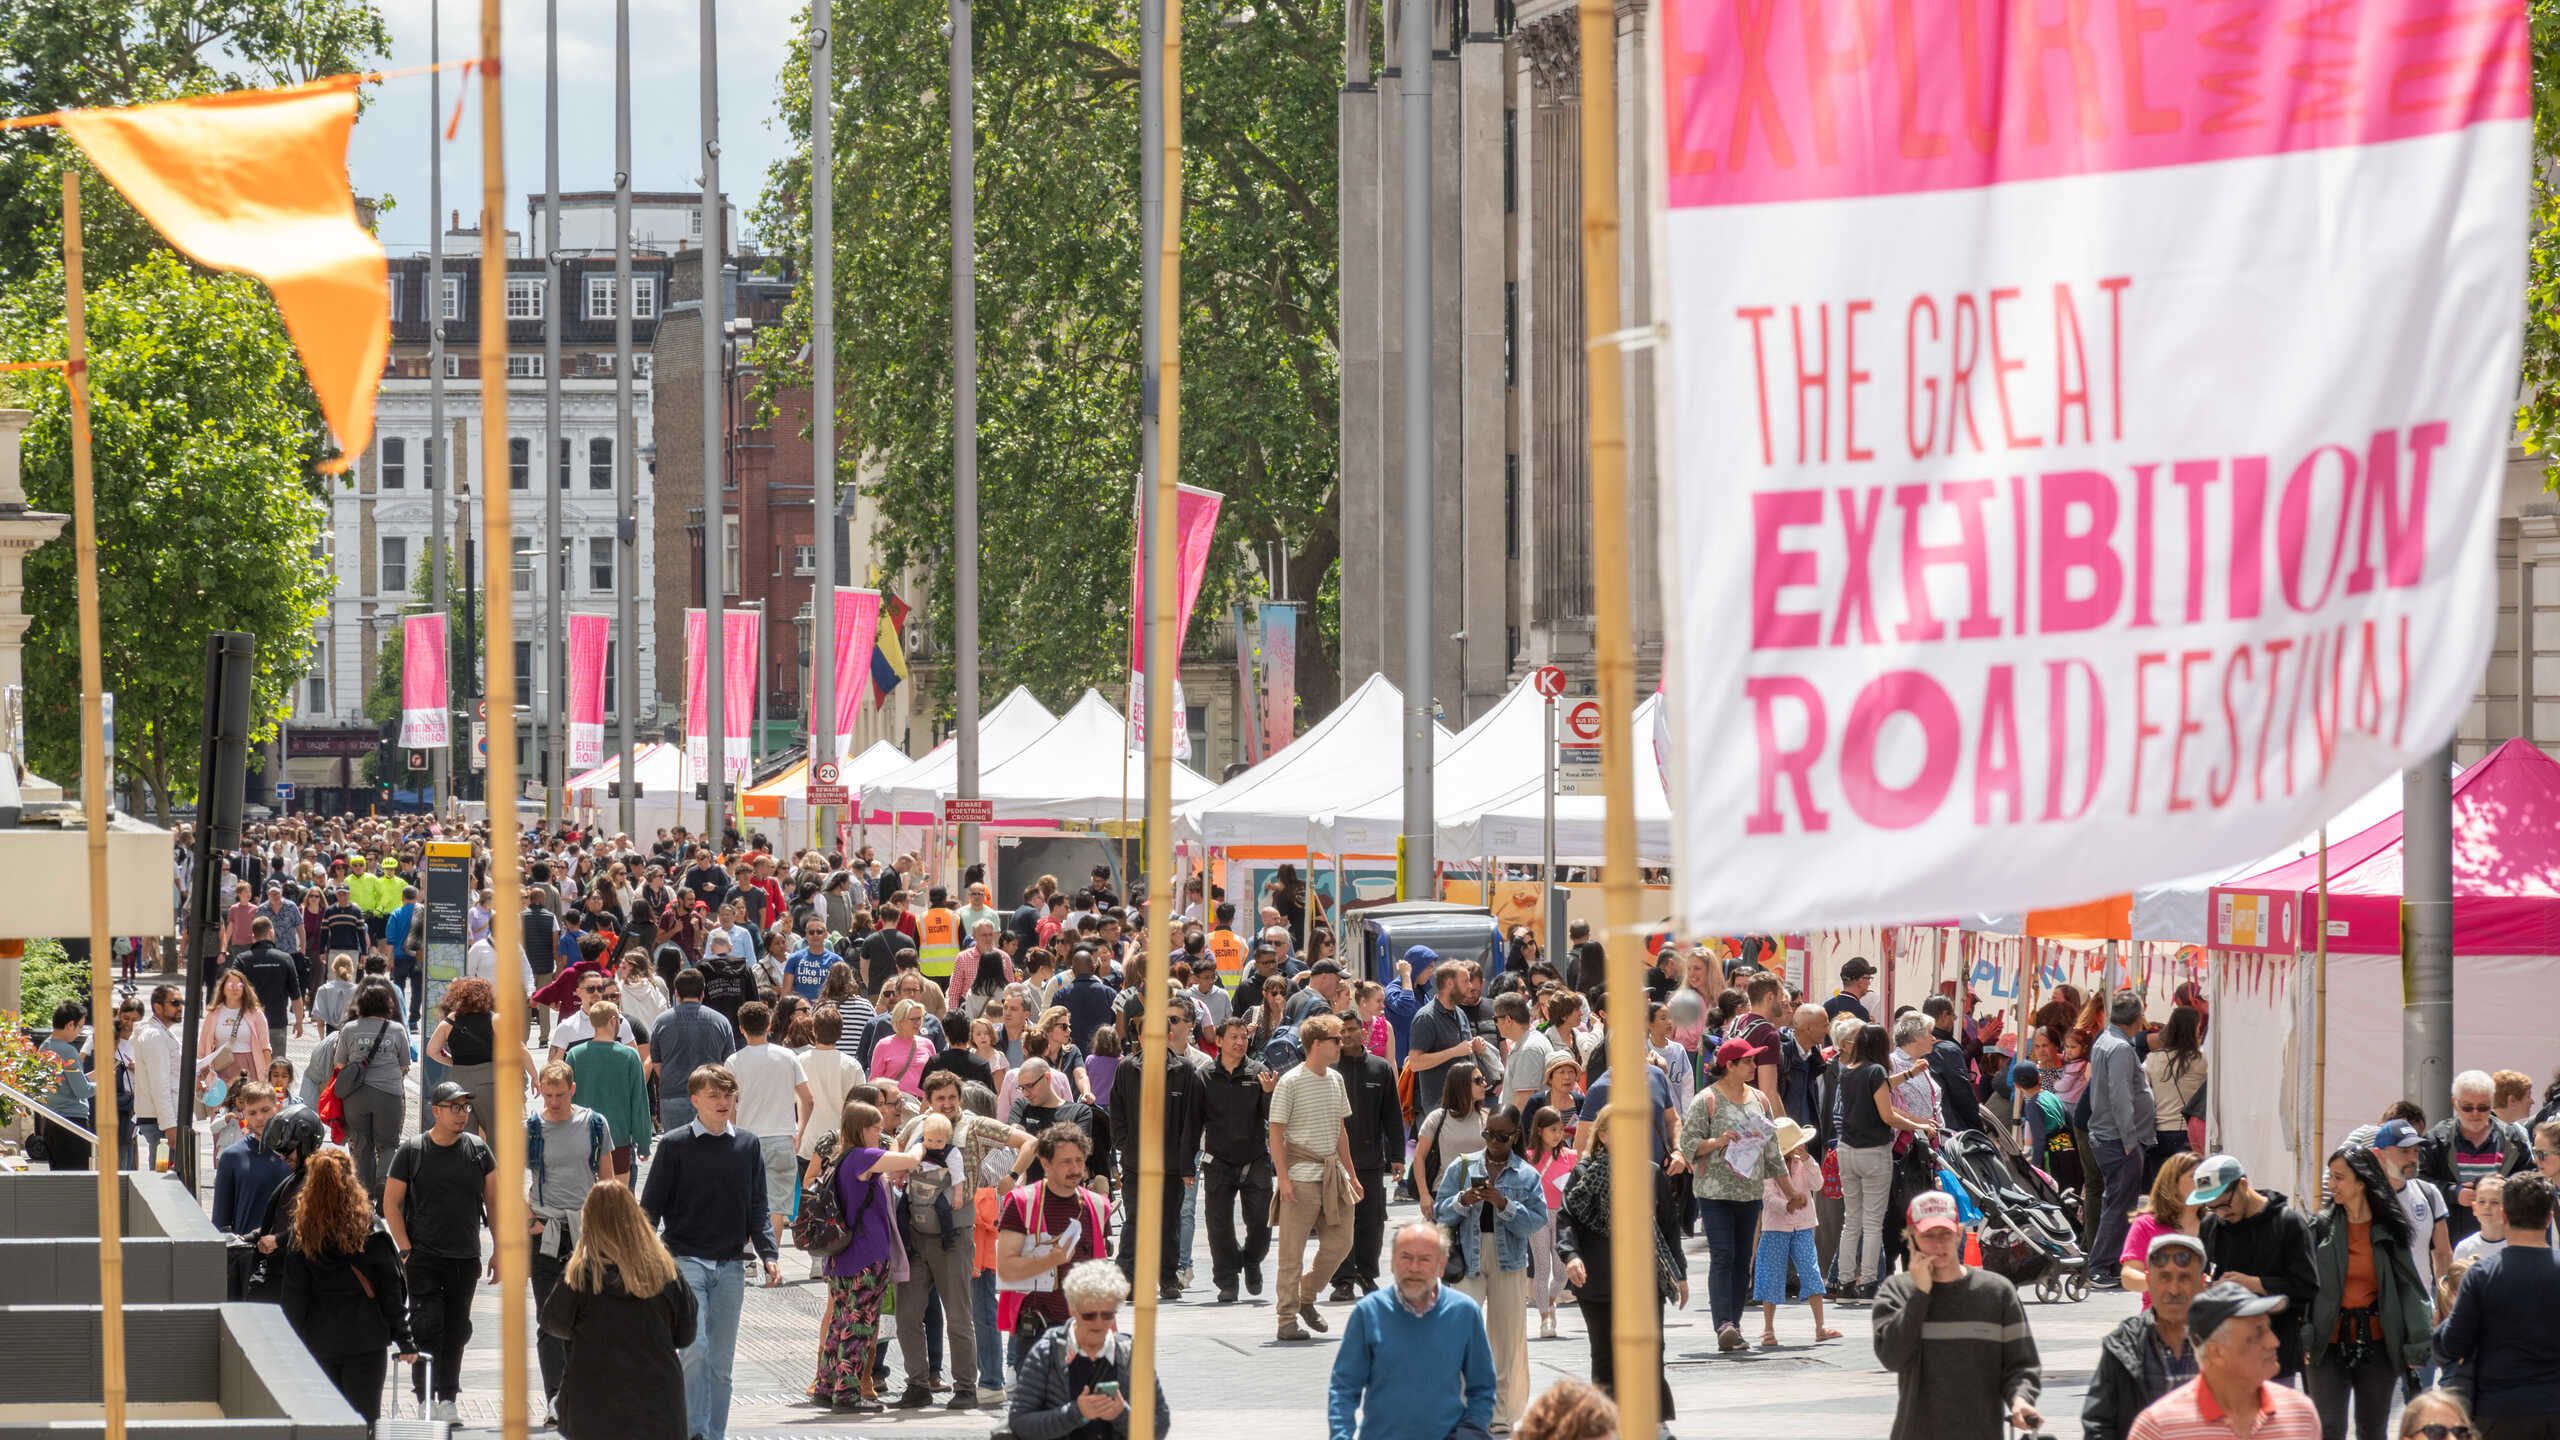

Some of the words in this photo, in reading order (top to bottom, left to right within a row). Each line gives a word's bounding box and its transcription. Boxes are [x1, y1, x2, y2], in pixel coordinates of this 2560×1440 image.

[1736, 298, 1877, 467] THE
[1906, 275, 2134, 461] GREAT
[1750, 420, 2450, 651] EXHIBITION
[1541, 671, 1559, 693] K
[821, 768, 837, 778] 20
[1745, 657, 2107, 837] ROAD
[946, 807, 992, 815] PEDESTRIANS
